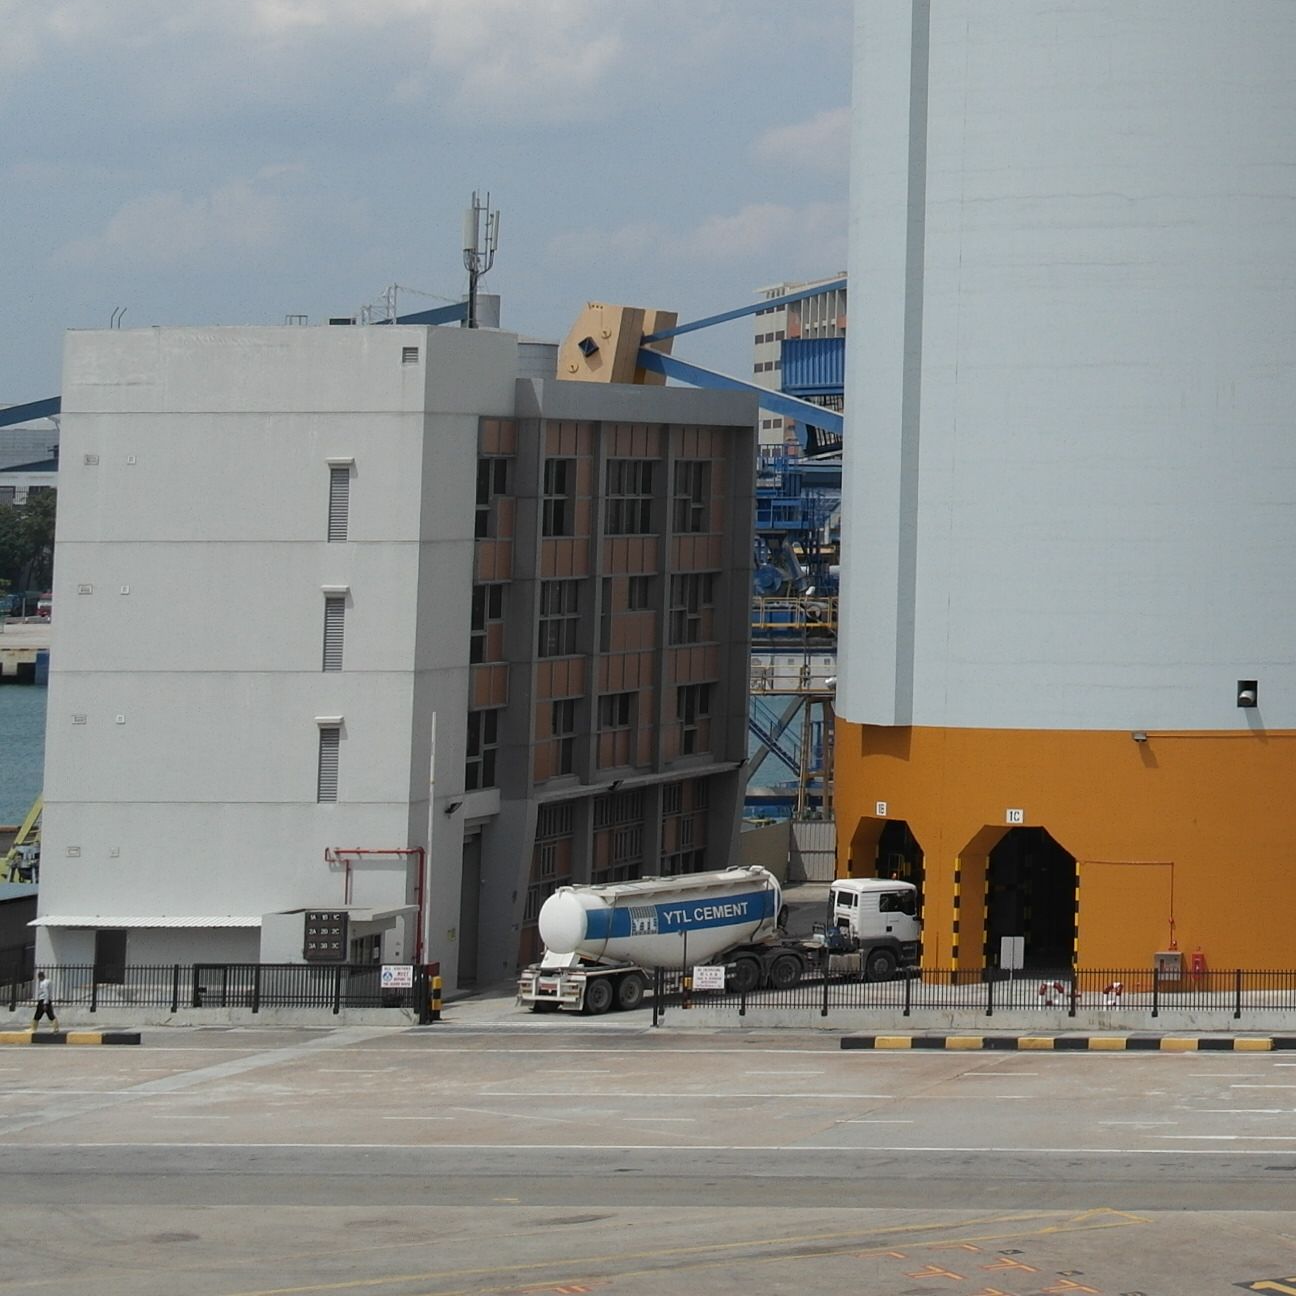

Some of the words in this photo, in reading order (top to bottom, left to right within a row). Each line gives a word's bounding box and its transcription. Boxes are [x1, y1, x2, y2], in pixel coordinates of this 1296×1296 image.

[1009, 810, 1020, 821] 1C
[663, 910, 692, 925] YTL
[693, 902, 748, 921] CEMENT
